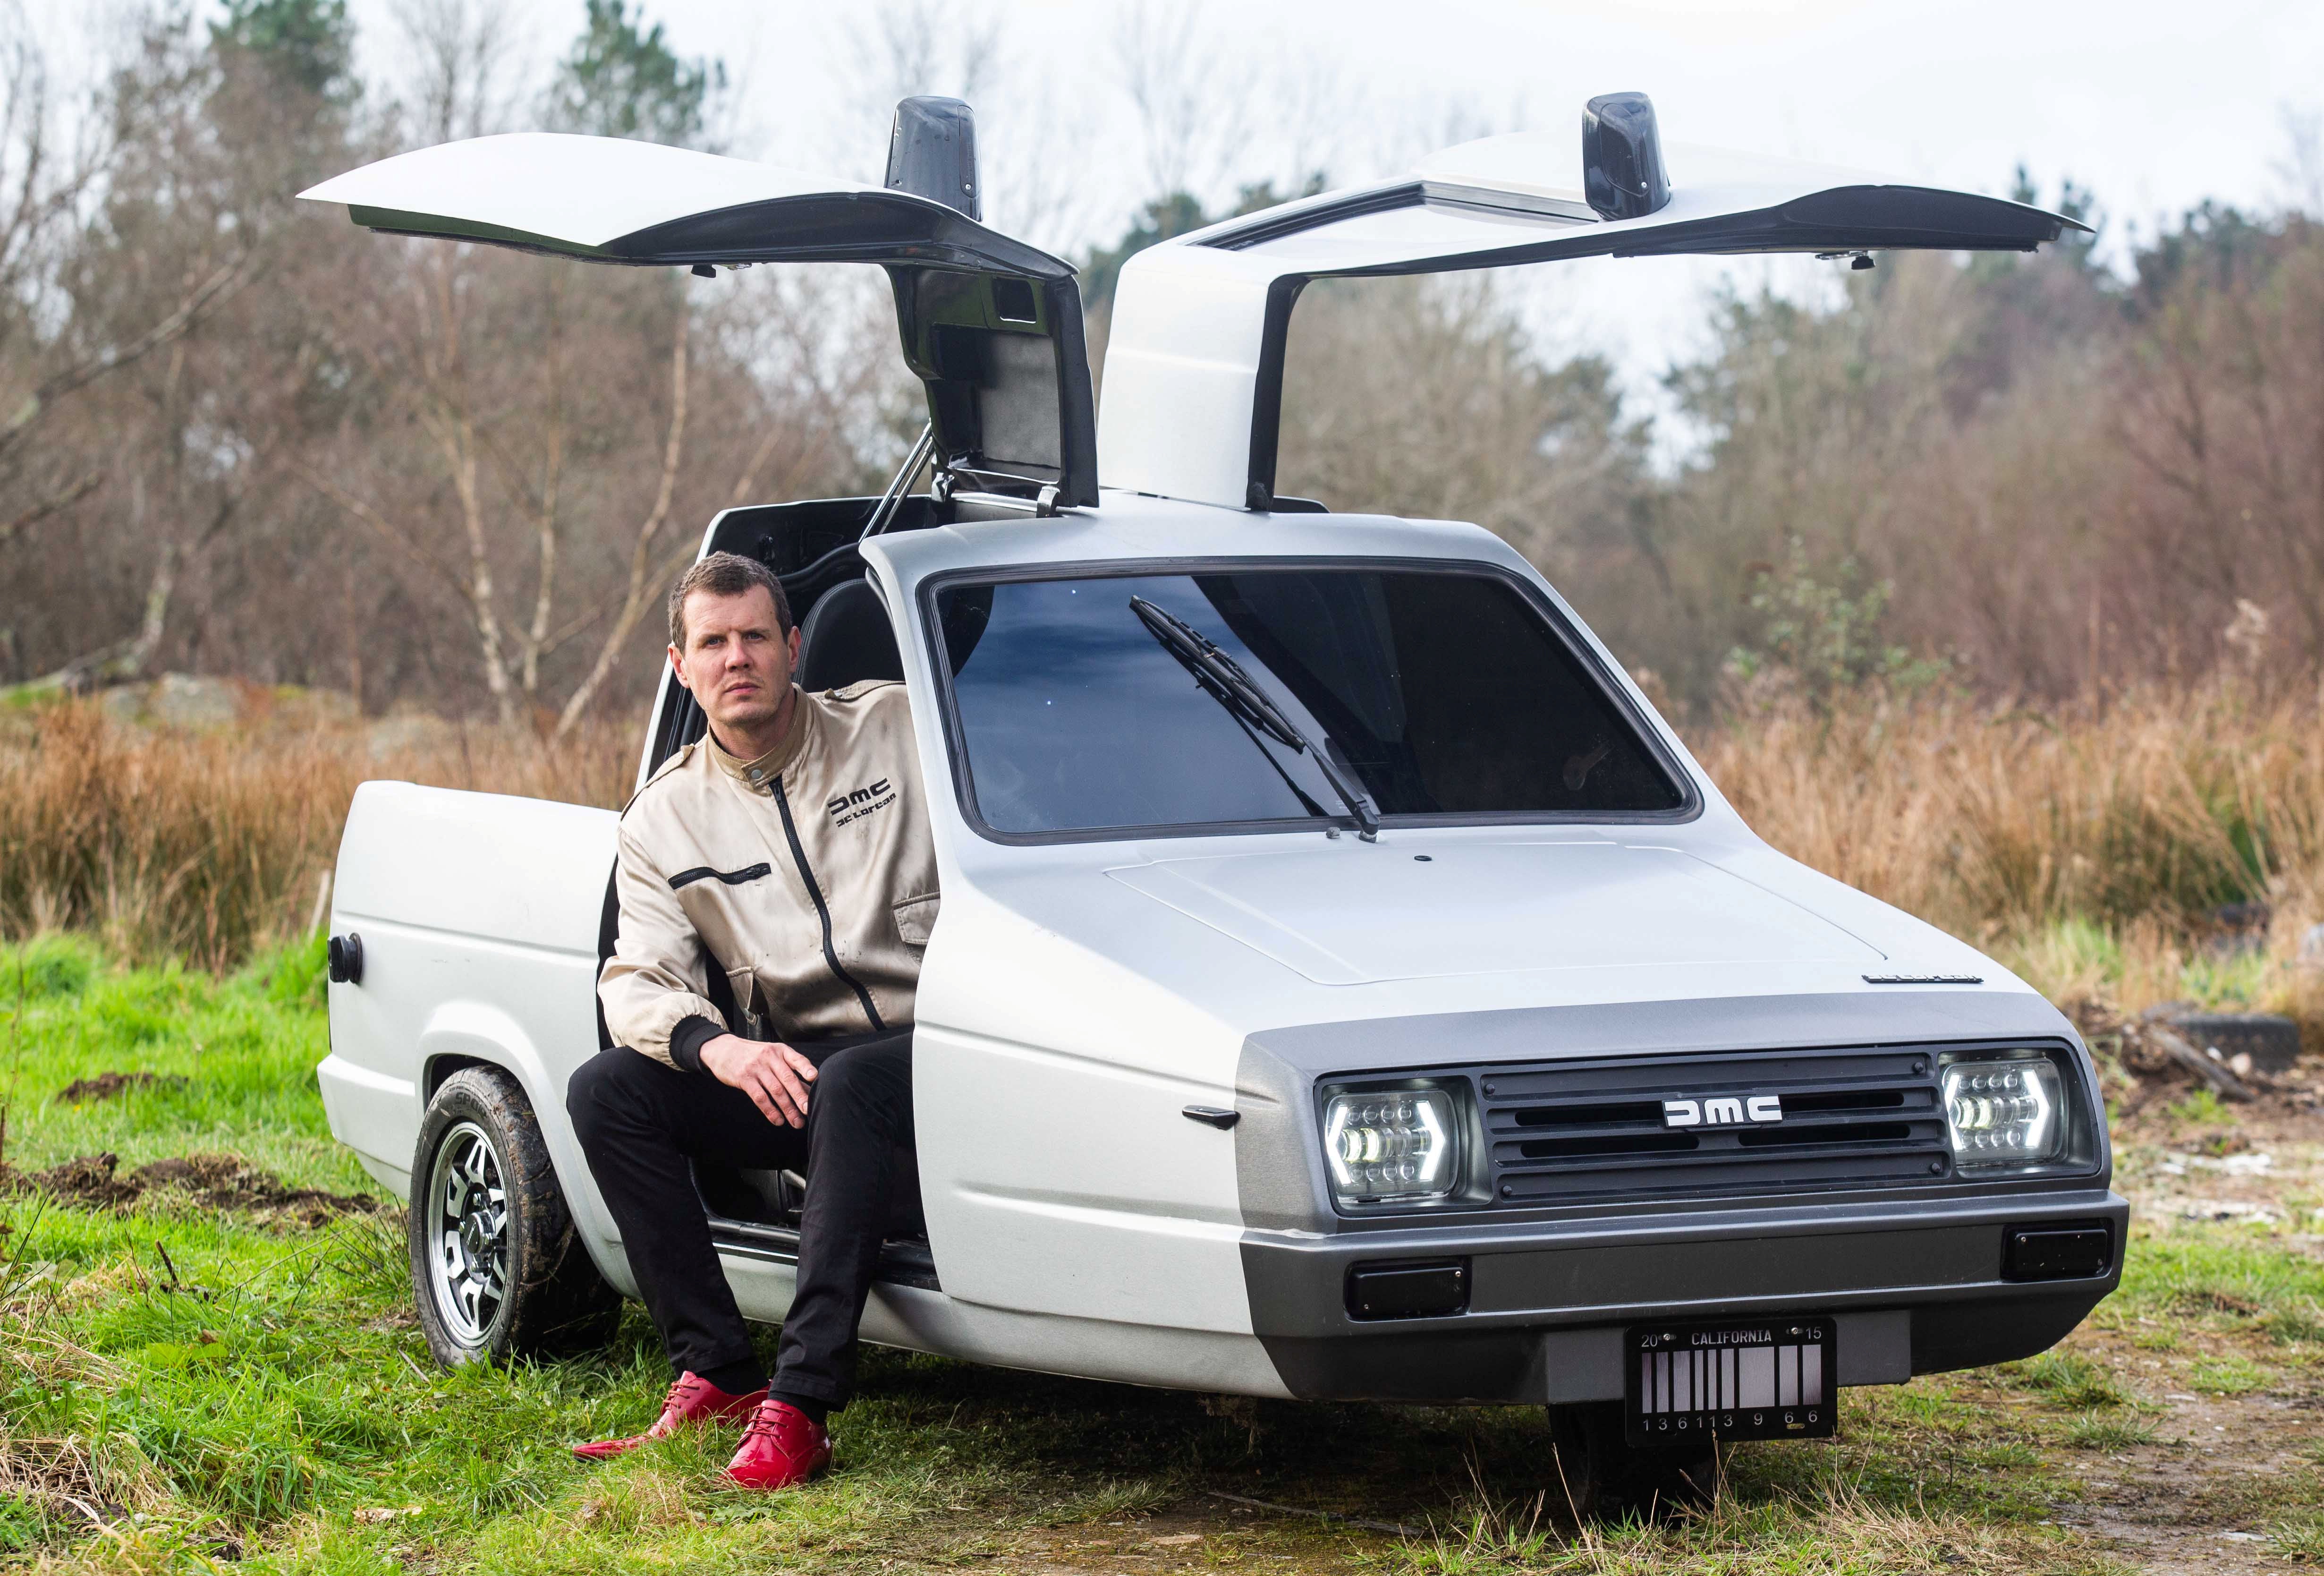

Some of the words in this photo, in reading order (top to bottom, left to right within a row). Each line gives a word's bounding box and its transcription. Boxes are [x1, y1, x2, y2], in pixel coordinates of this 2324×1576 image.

[1641, 1334, 1658, 1347] 20
[1692, 1329, 1772, 1345] CALIFORNIA
[1806, 1327, 1821, 1339] 15
